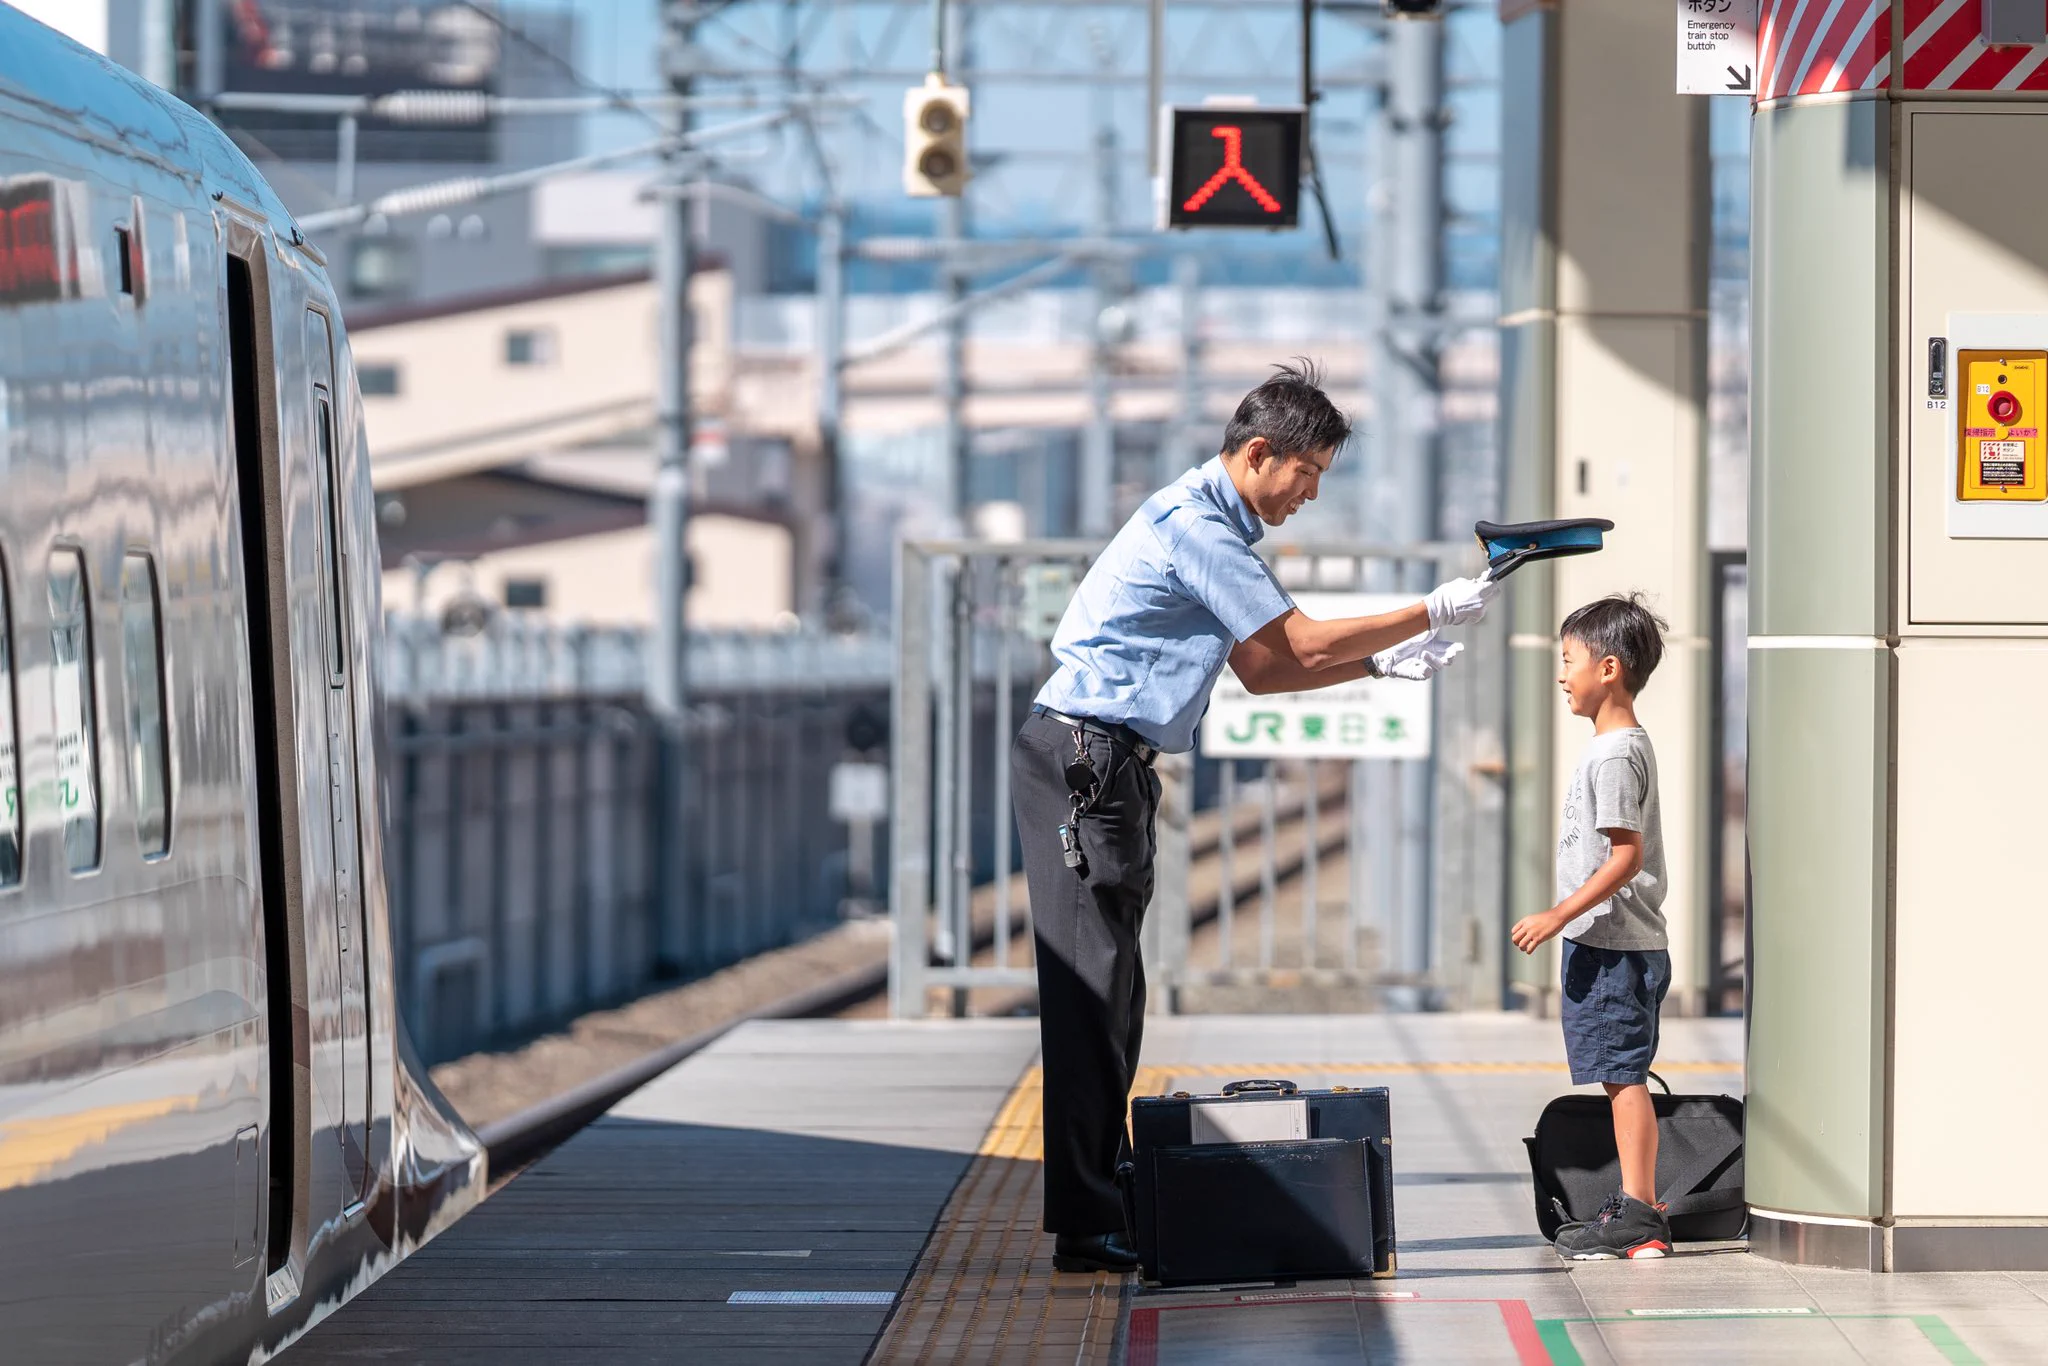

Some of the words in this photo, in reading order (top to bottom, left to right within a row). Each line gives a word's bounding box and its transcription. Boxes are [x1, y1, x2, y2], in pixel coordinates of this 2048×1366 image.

[1687, 20, 1736, 30] Emergency
[1687, 31, 1707, 40] train
[1710, 32, 1729, 40] stop
[1687, 41, 1716, 51] button
[1927, 400, 1946, 409] B12
